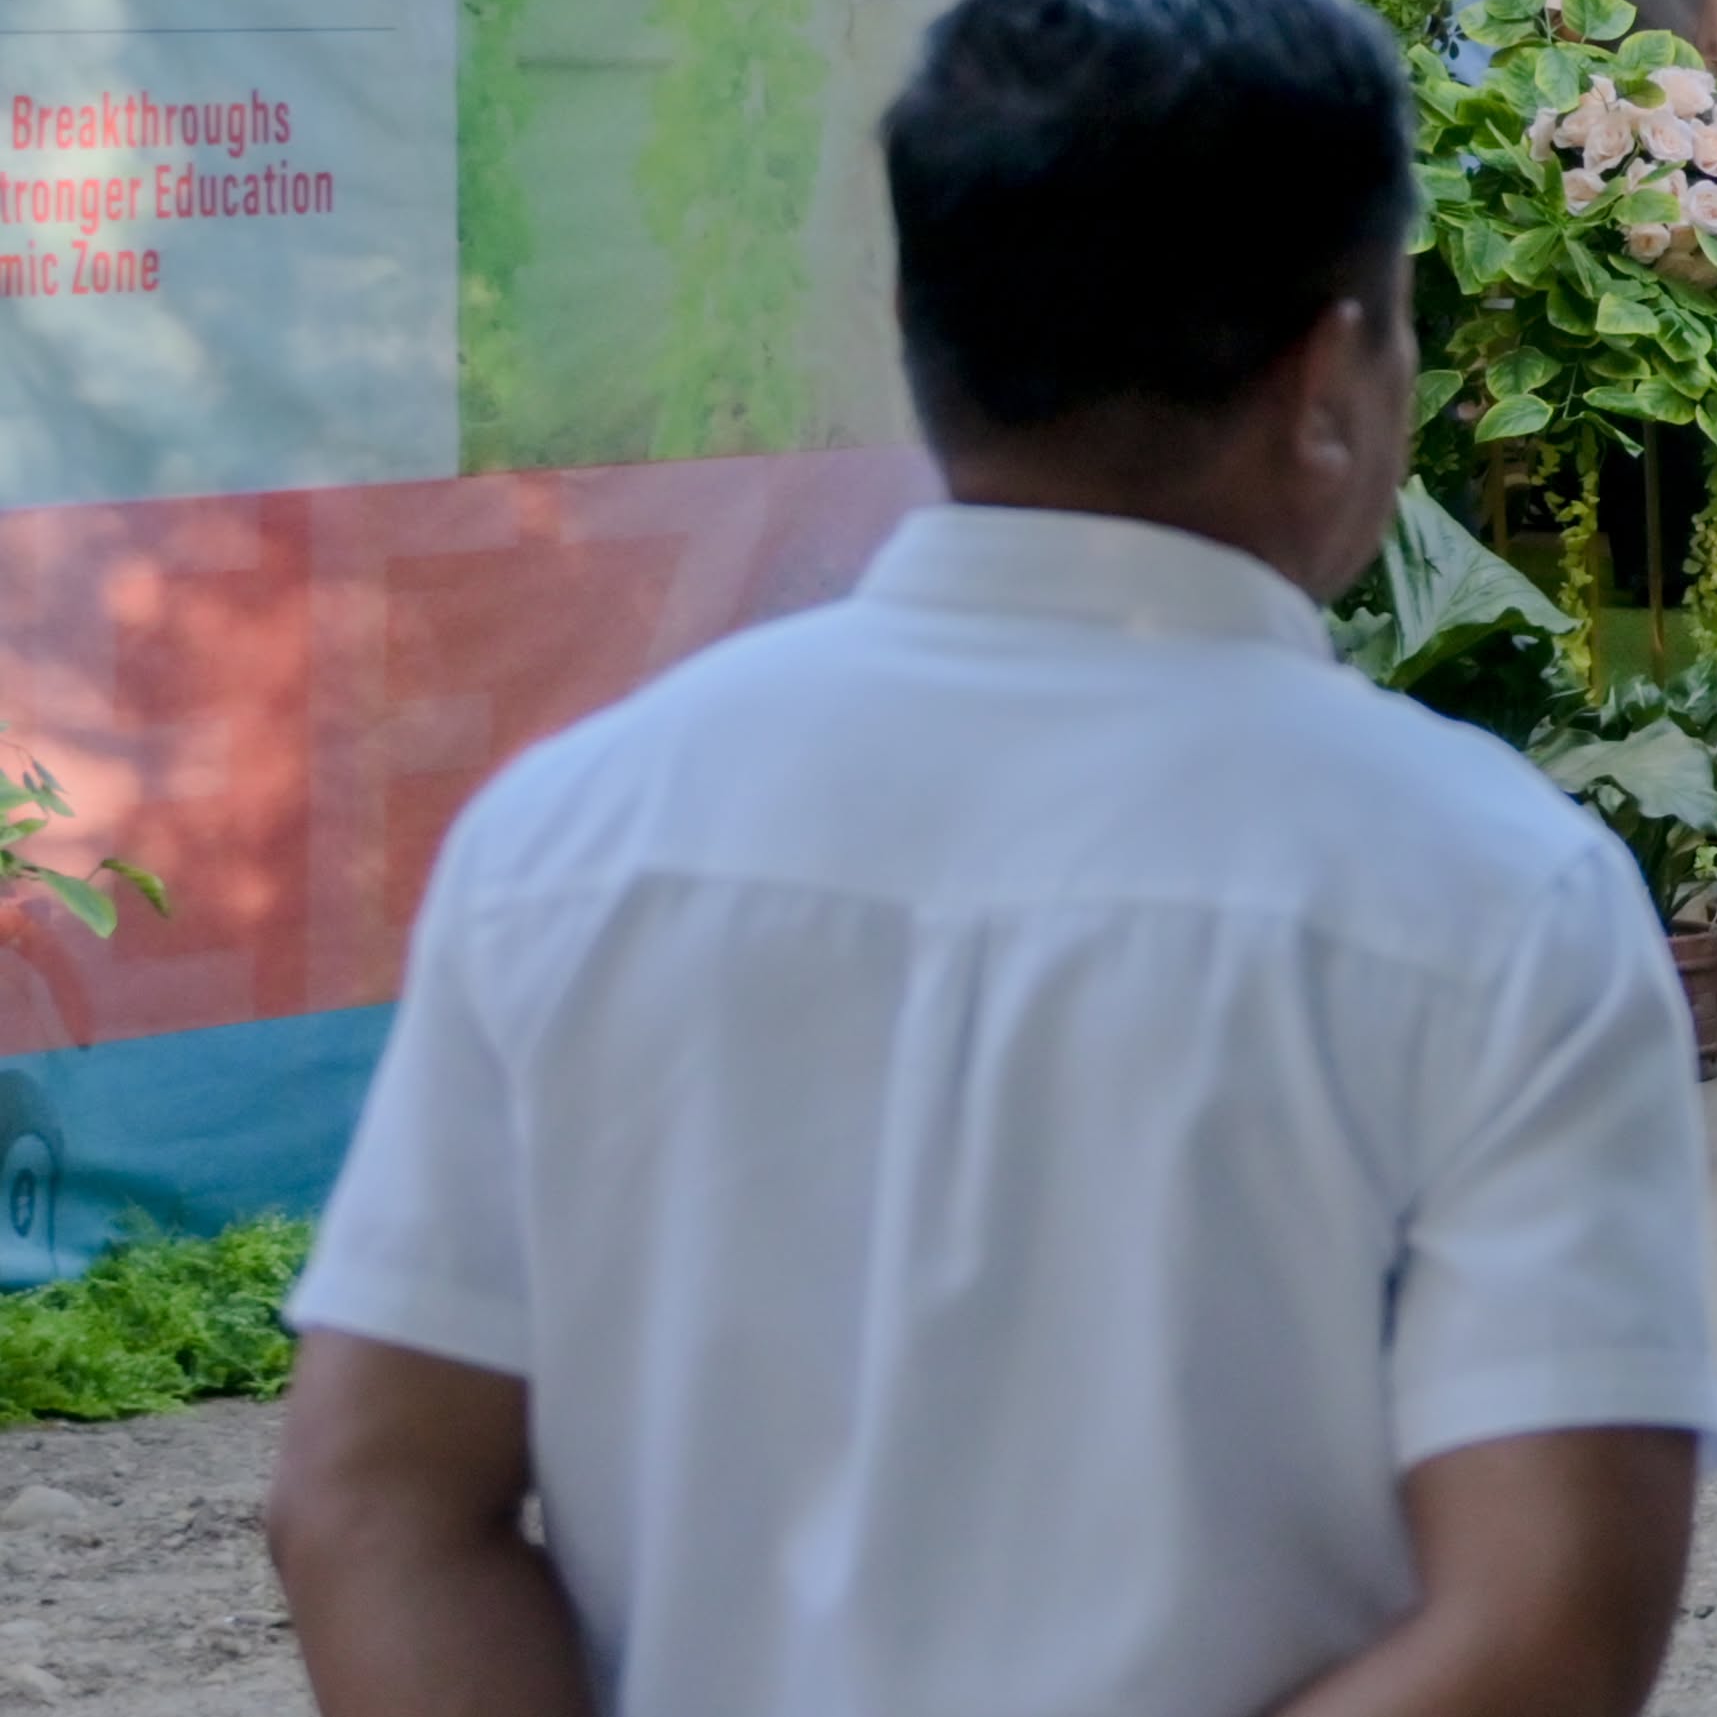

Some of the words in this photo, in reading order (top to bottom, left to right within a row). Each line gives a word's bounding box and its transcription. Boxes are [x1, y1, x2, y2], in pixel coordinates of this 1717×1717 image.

[13, 89, 291, 159] Breakthroughs
[155, 160, 334, 219] Education
[71, 238, 161, 295] Zone
